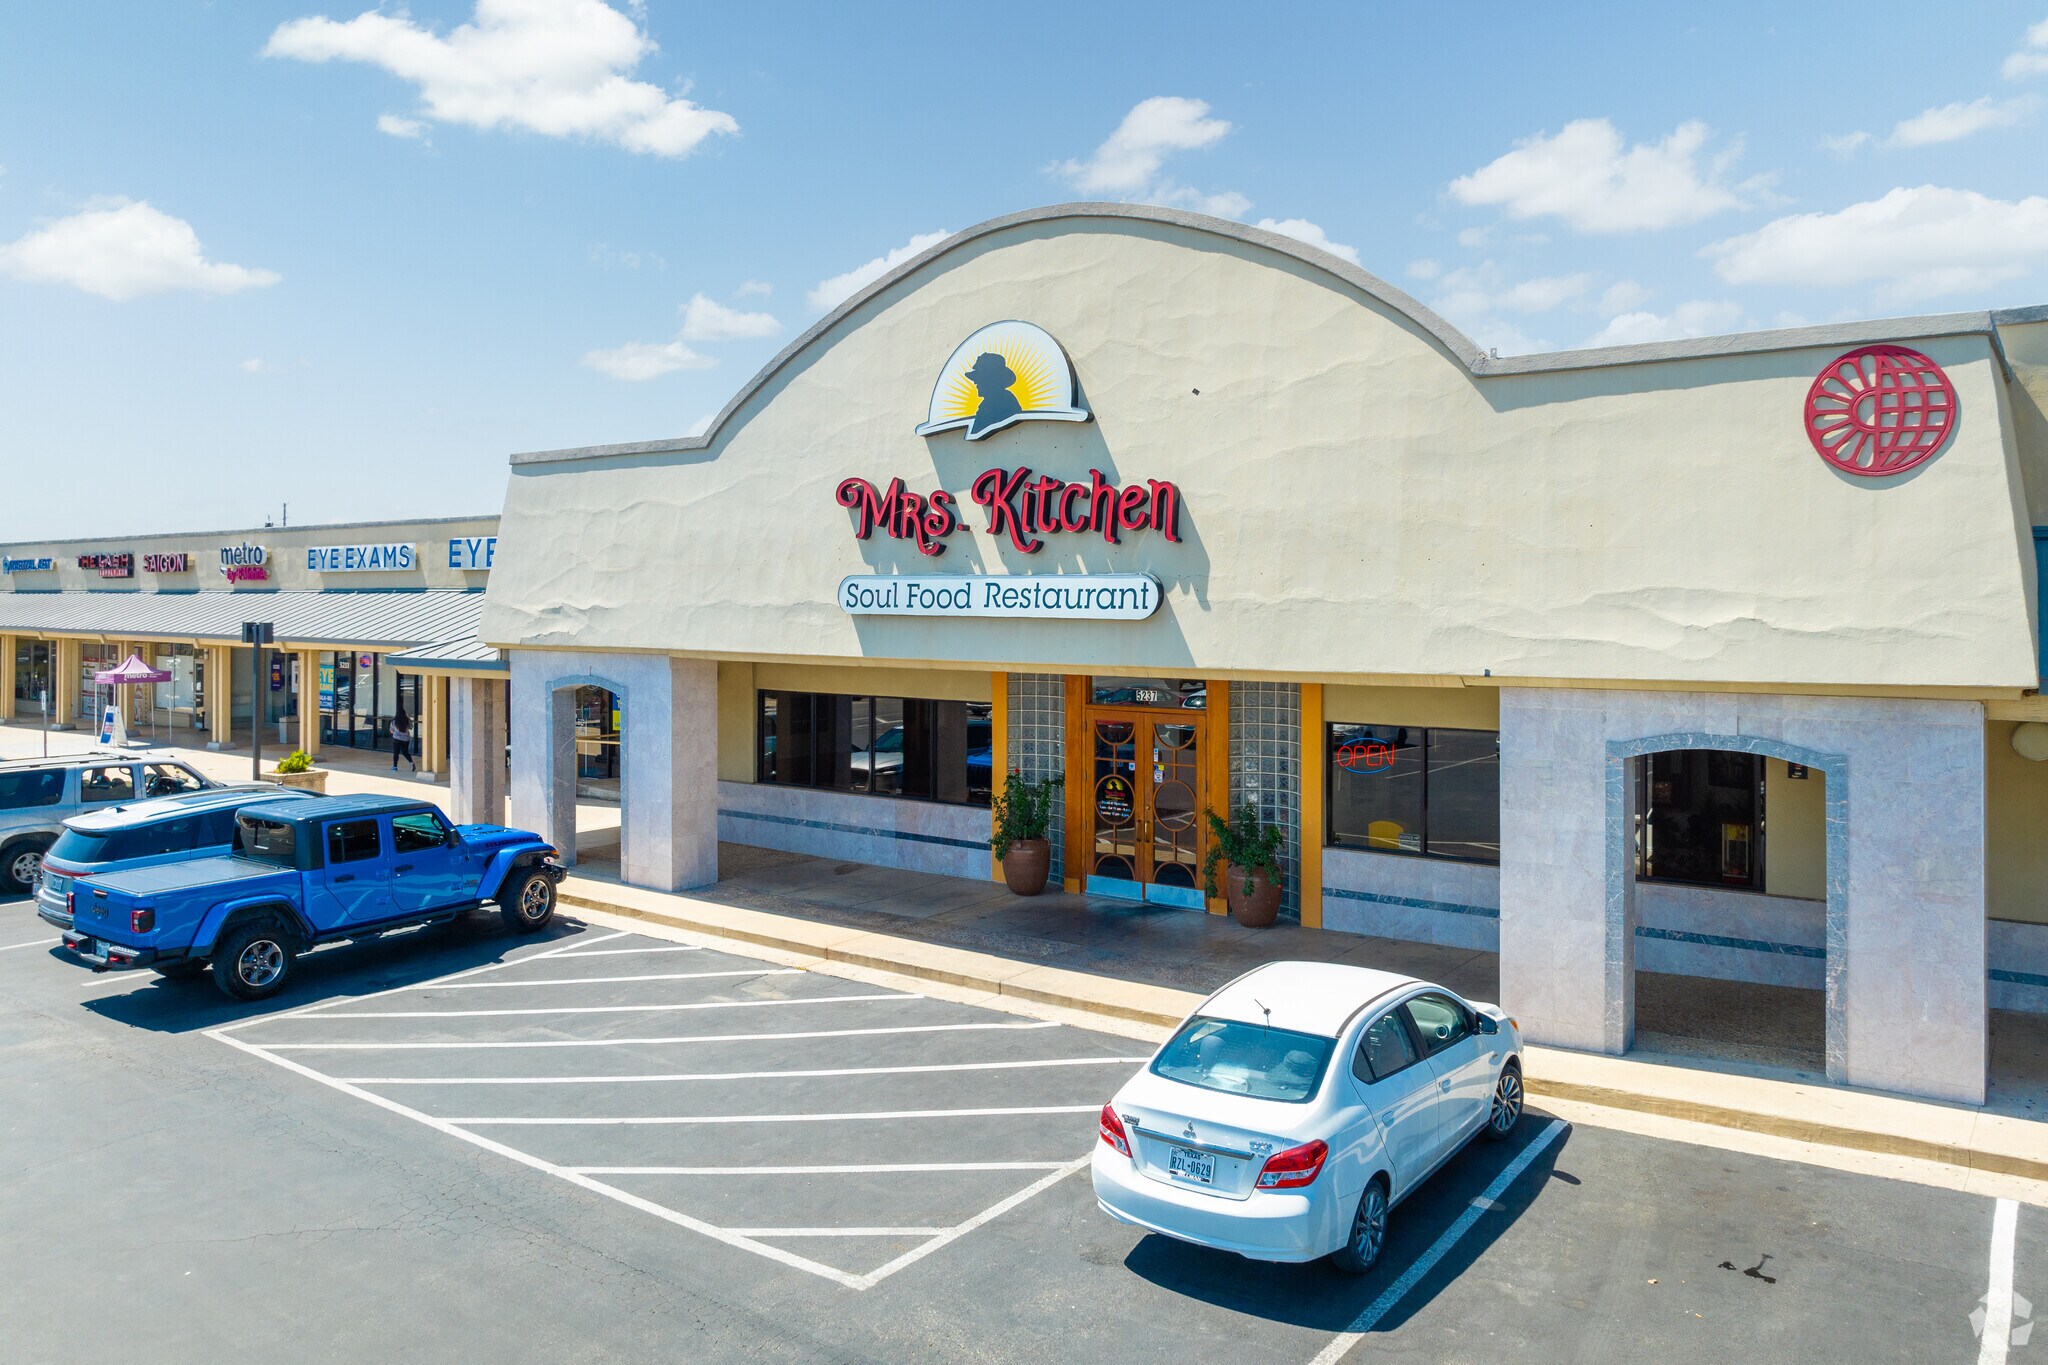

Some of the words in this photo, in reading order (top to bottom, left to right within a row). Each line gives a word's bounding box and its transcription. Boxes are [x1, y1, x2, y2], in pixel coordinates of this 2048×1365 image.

[971, 466, 1182, 554] Kitchen
[76, 555, 96, 568] THE
[98, 553, 129, 567] LASH
[143, 553, 185, 573] SAIGON
[220, 541, 263, 565] metro
[307, 548, 339, 570] EYE
[345, 544, 410, 568] EXAMS
[448, 538, 498, 568] EYE
[845, 582, 899, 609] Soul
[906, 582, 972, 609] Food
[983, 581, 1150, 610] Restaurant
[1136, 690, 1158, 702] 5237
[1336, 743, 1395, 768] OPEN
[1184, 1151, 1201, 1161] TEXAS
